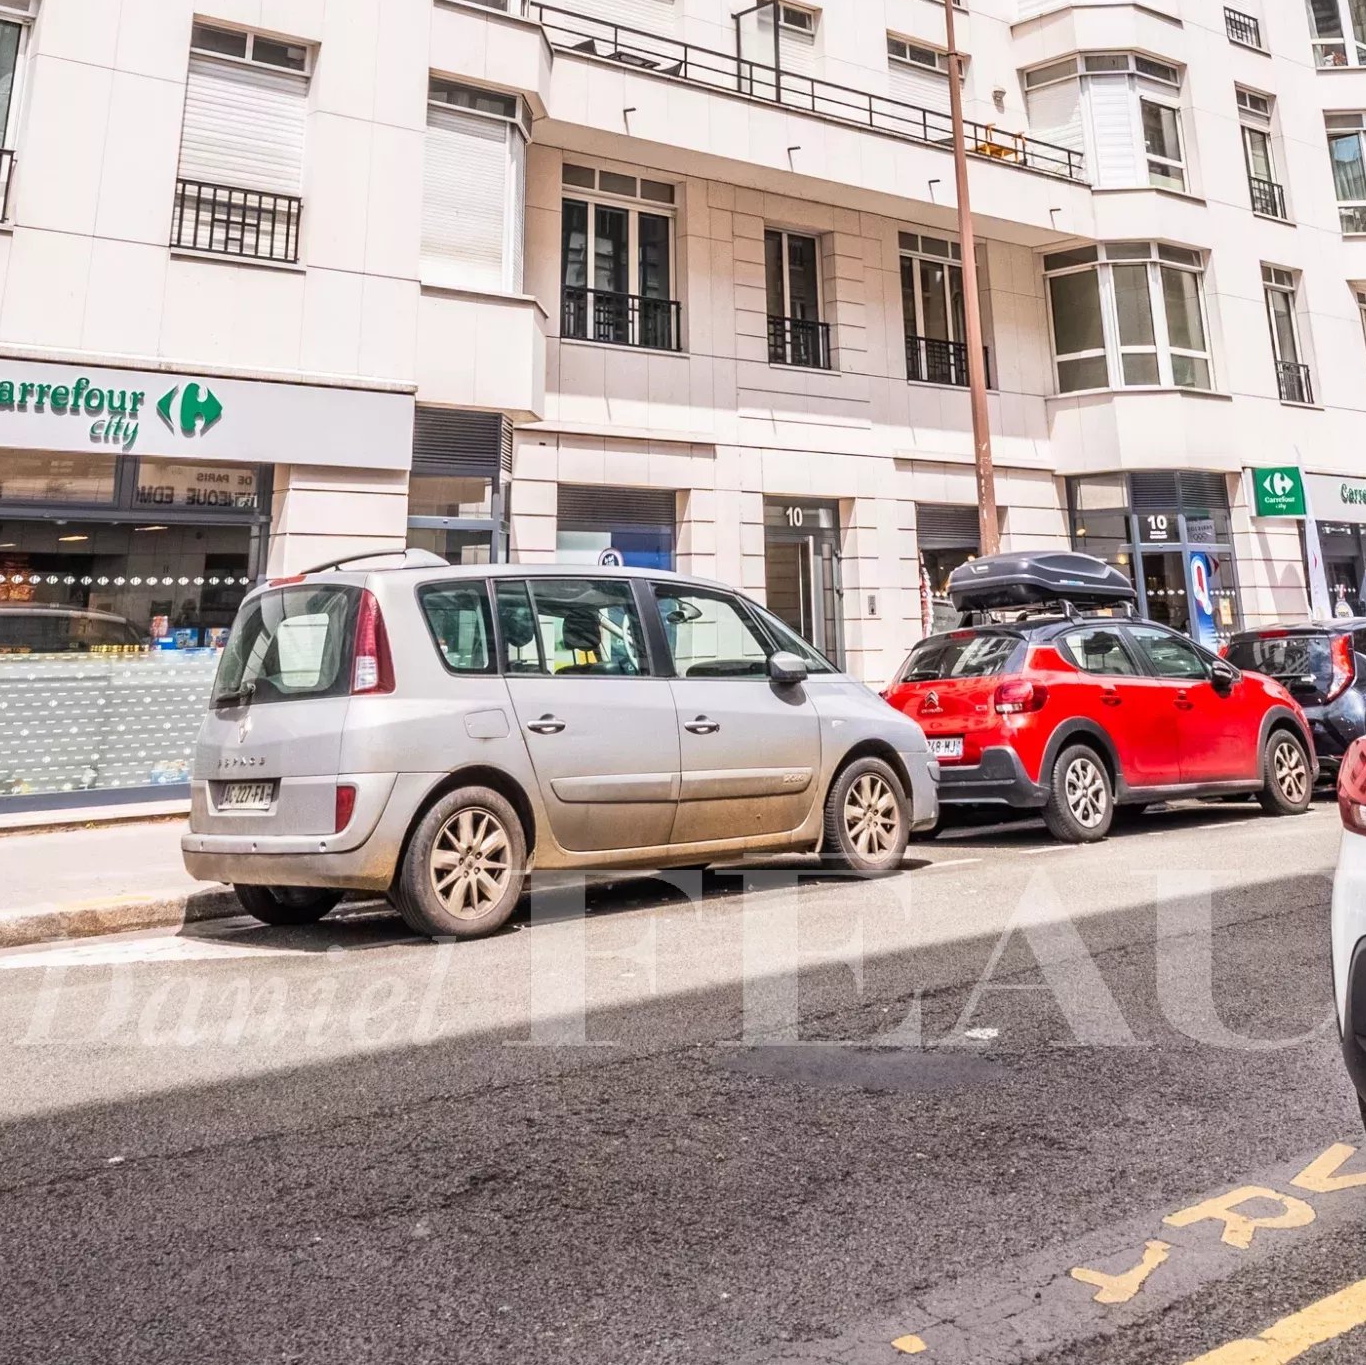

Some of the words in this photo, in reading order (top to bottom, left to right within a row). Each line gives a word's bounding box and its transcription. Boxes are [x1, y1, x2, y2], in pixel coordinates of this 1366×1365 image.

[89, 415, 140, 452] city
[1264, 495, 1296, 504] Carrefour
[785, 506, 803, 527] 10
[1146, 514, 1168, 530] 10
